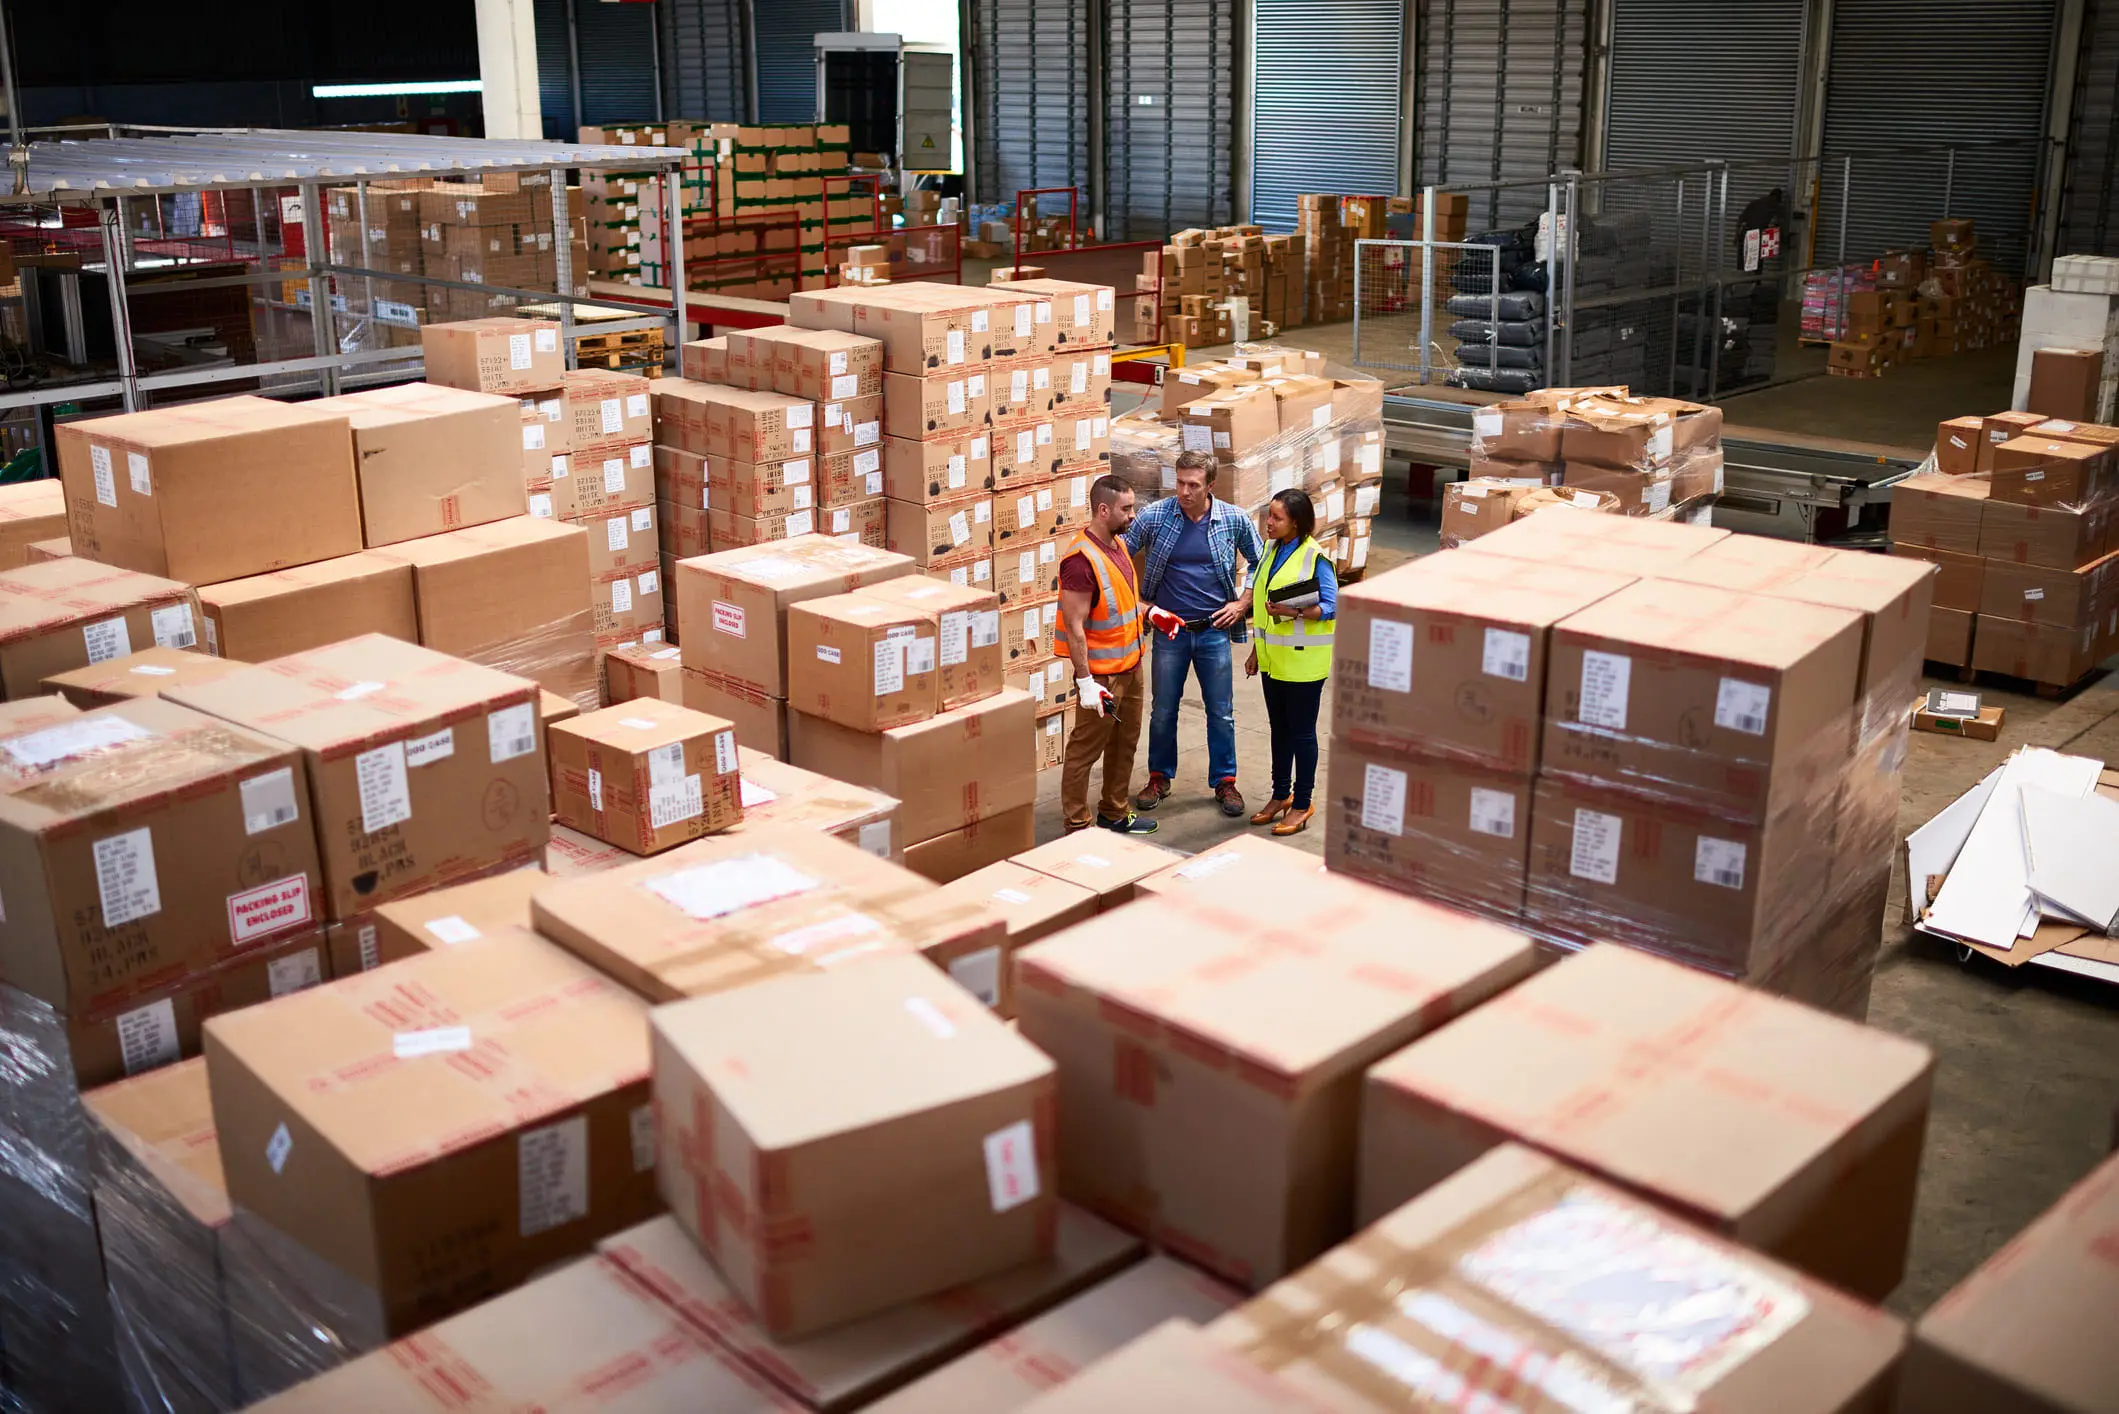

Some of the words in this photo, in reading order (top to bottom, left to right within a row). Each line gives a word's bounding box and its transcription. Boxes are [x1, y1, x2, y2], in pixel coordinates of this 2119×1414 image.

[236, 893, 279, 916] PACKING
[281, 886, 302, 903] SLIP
[246, 904, 295, 927] ENCLOSED
